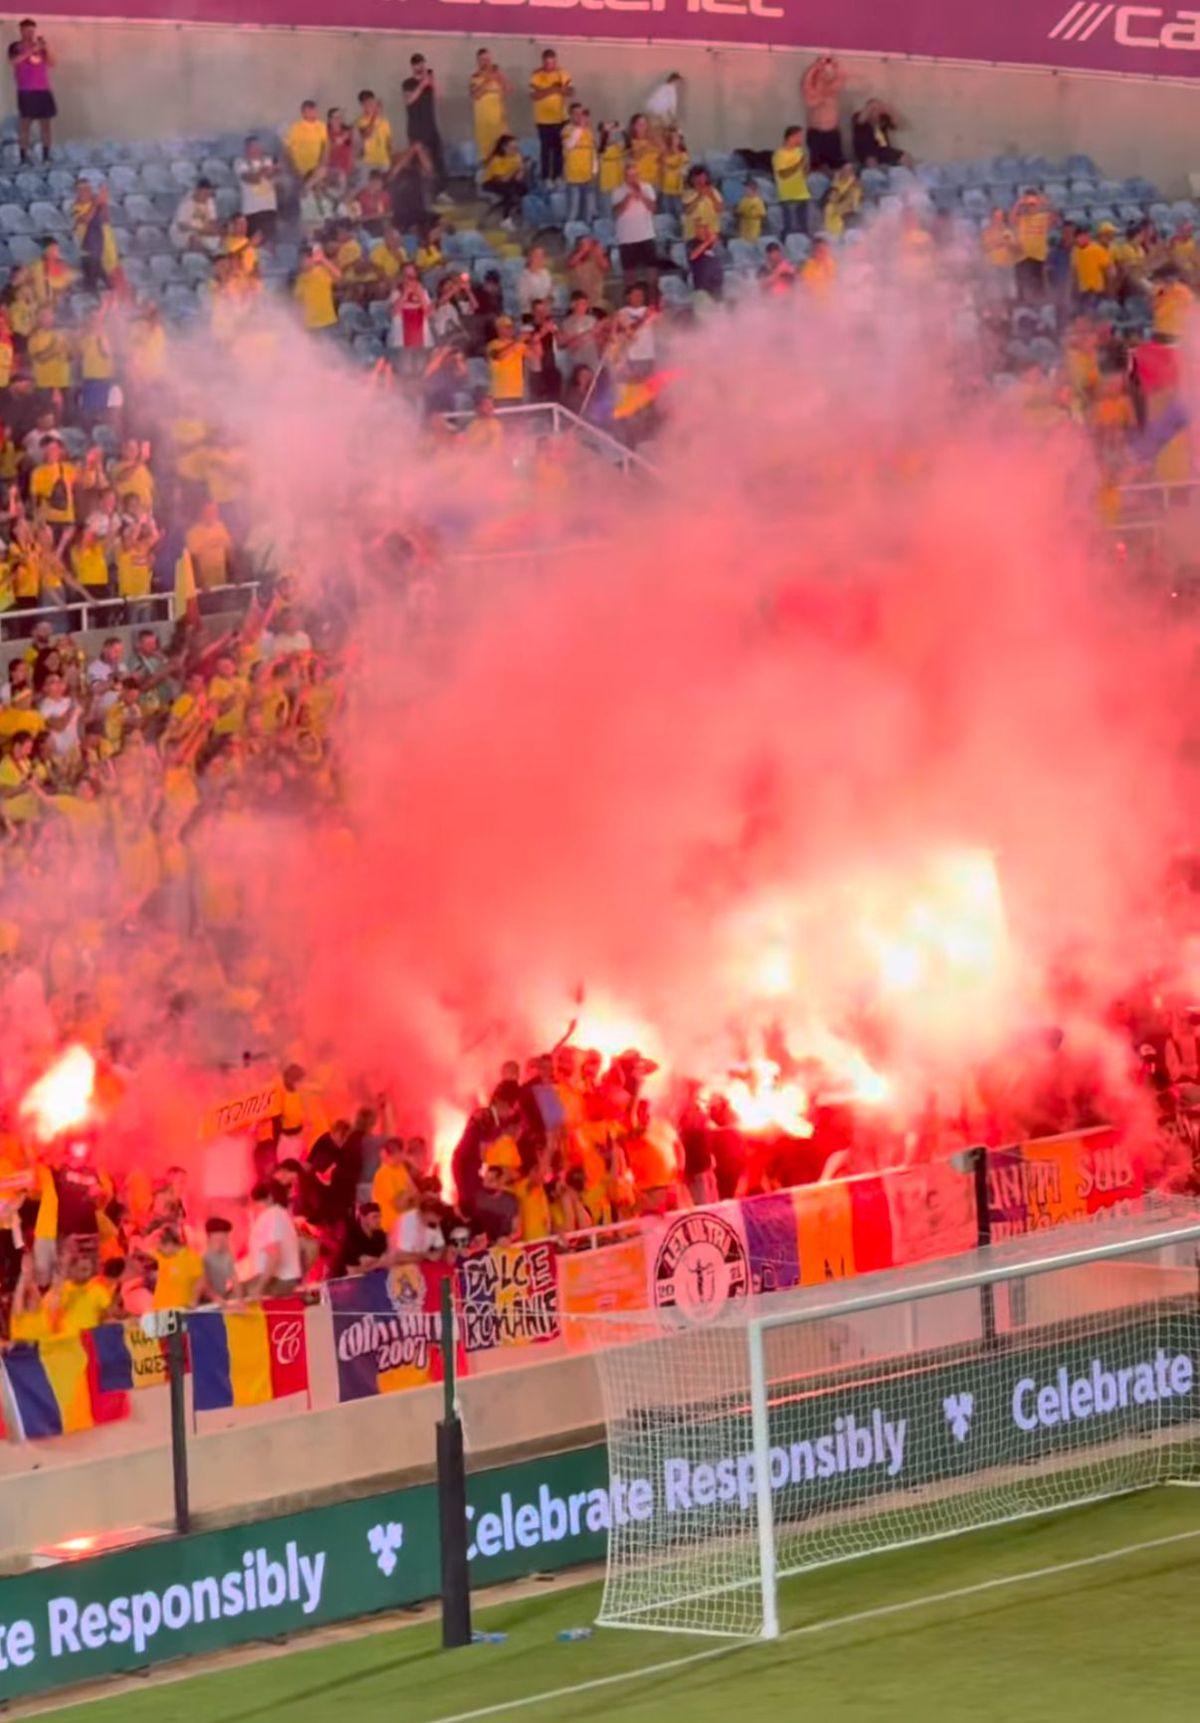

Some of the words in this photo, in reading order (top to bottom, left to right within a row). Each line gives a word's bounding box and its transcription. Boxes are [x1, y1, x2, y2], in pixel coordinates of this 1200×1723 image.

[464, 1247, 552, 1298] DULCE
[378, 1336, 427, 1368] 2007
[48, 1541, 326, 1656] Responsibly
[664, 1408, 907, 1512] Responsibly
[1012, 1350, 1193, 1430] Celebrate
